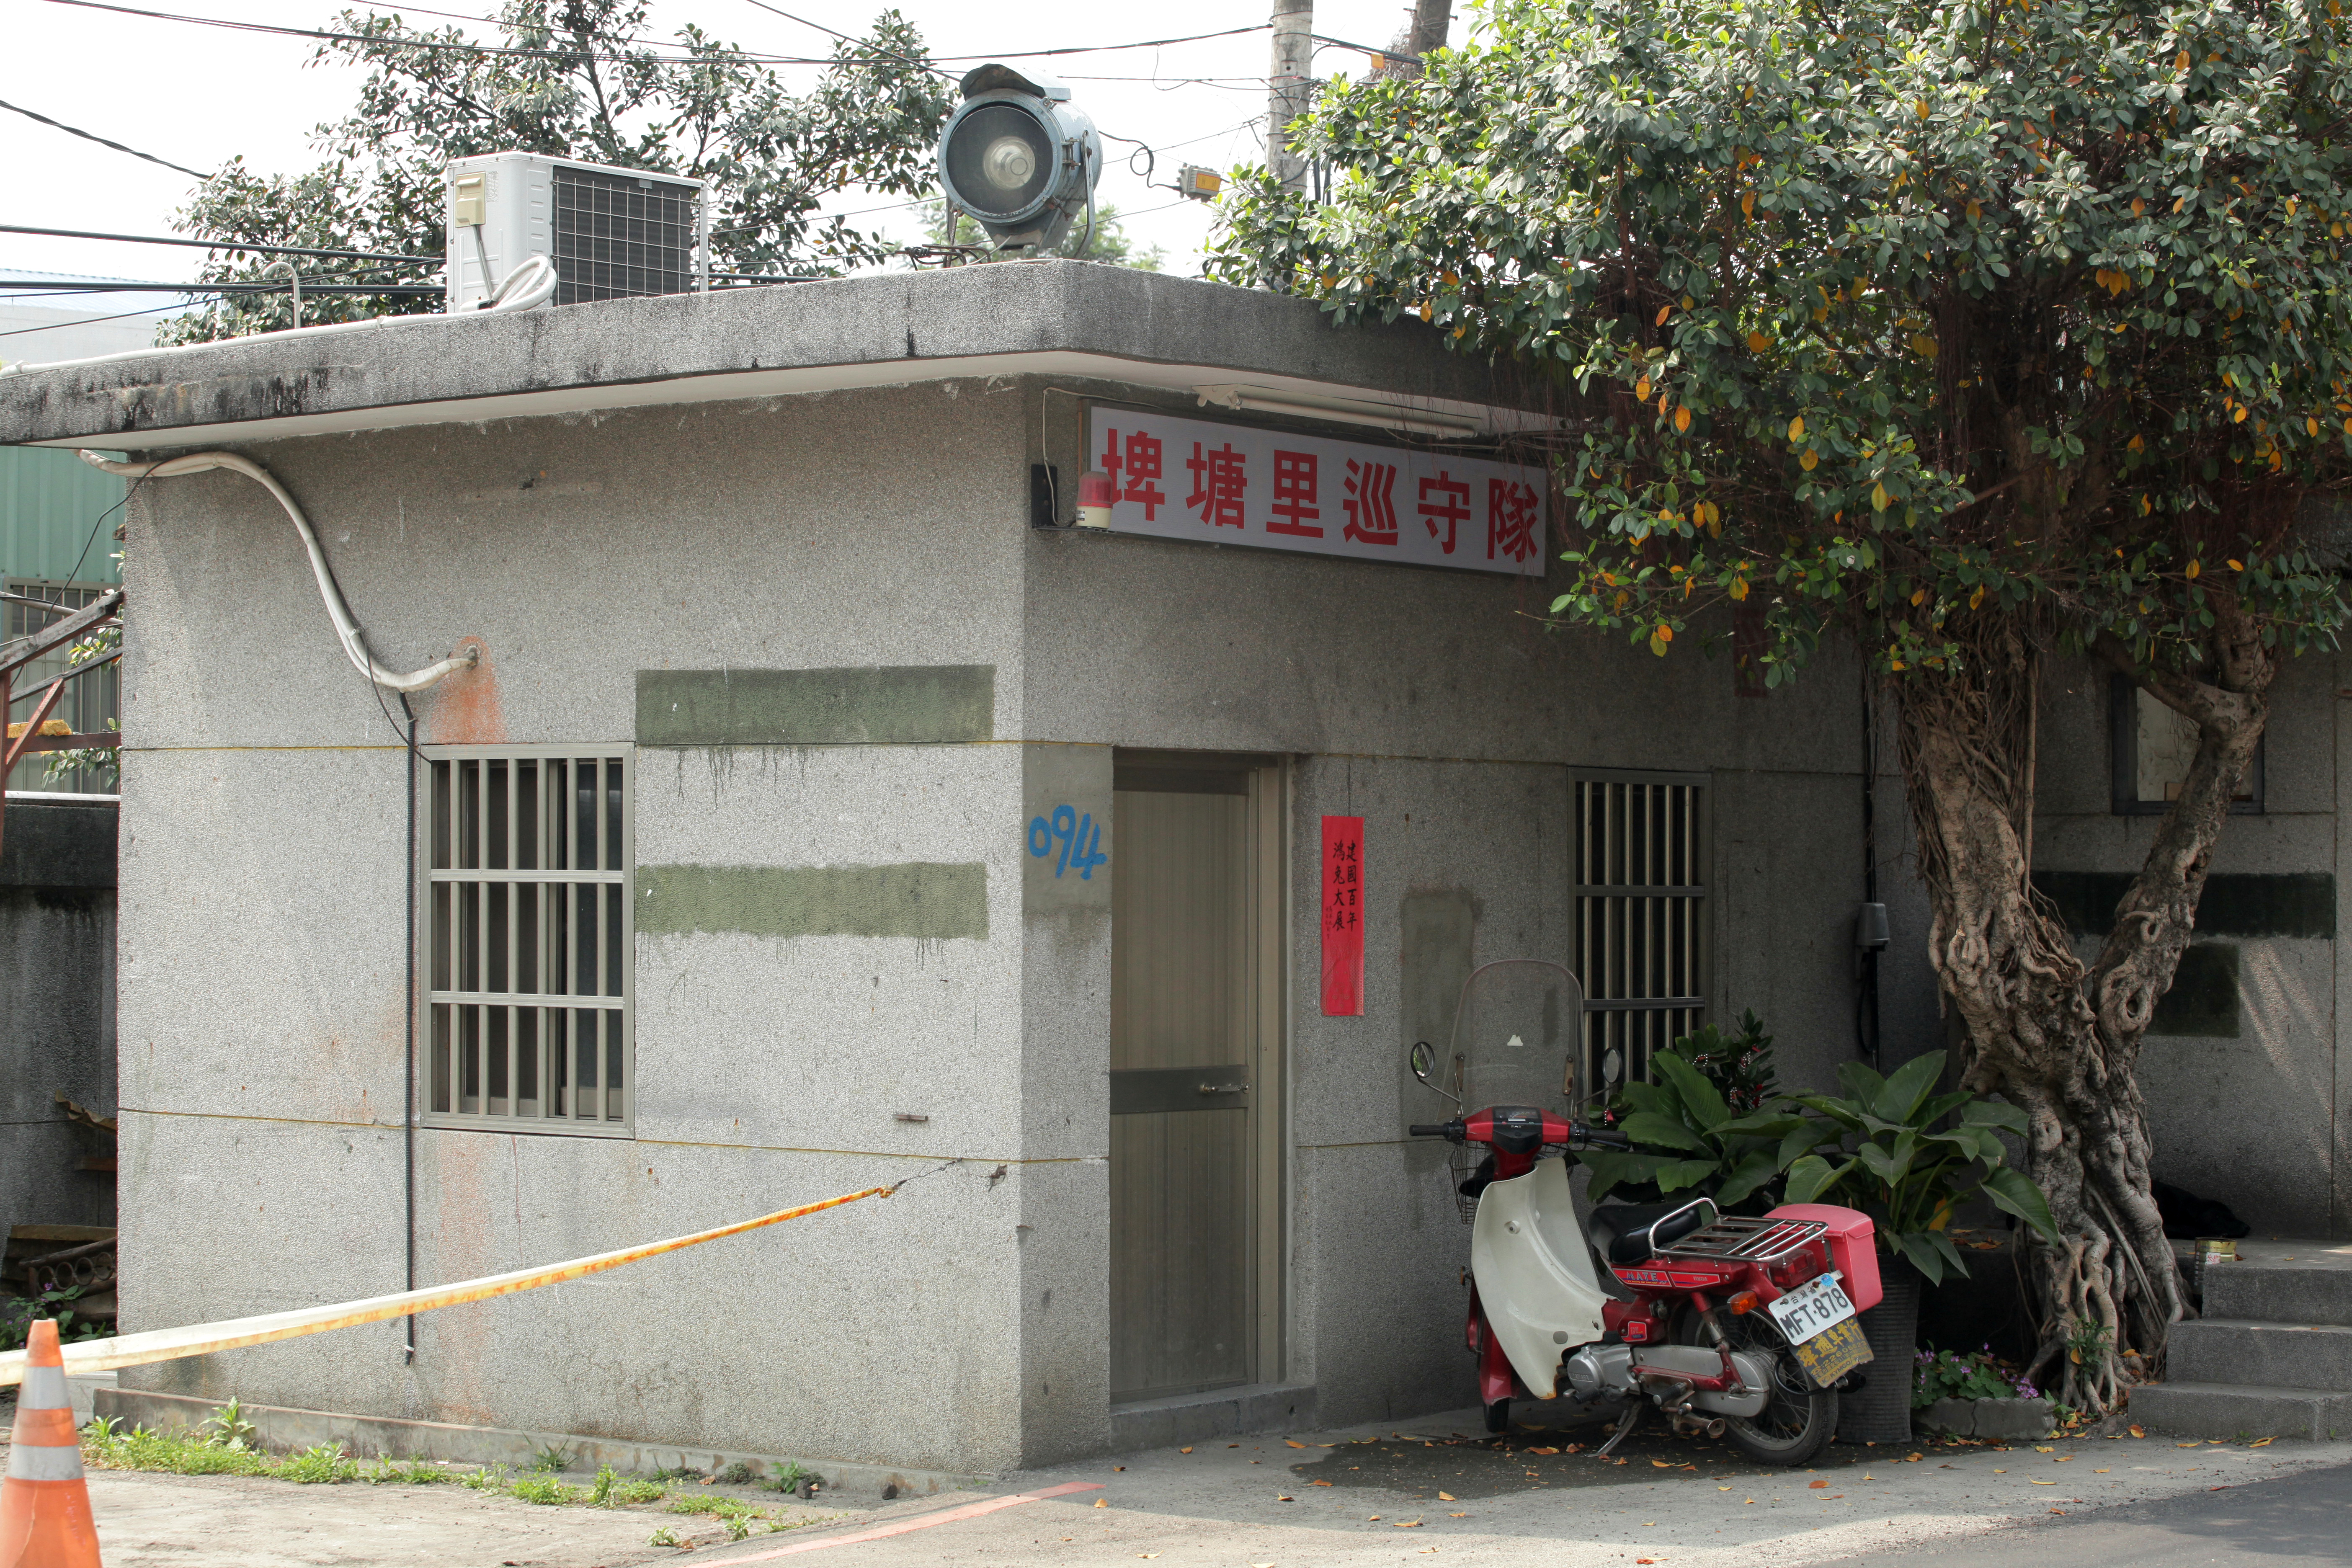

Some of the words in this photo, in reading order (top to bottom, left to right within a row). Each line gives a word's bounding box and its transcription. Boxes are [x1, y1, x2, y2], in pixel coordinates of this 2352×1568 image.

[1101, 428, 1539, 562] 埤塘里巡守隊
[1028, 805, 1107, 880] 094
[1332, 839, 1345, 932] 鴻兔大展
[1346, 839, 1357, 932] 建國百年
[1627, 1271, 1659, 1282] MATE
[1791, 1285, 1817, 1305] 台灣省
[1829, 1361, 1851, 1378] KYMCO
